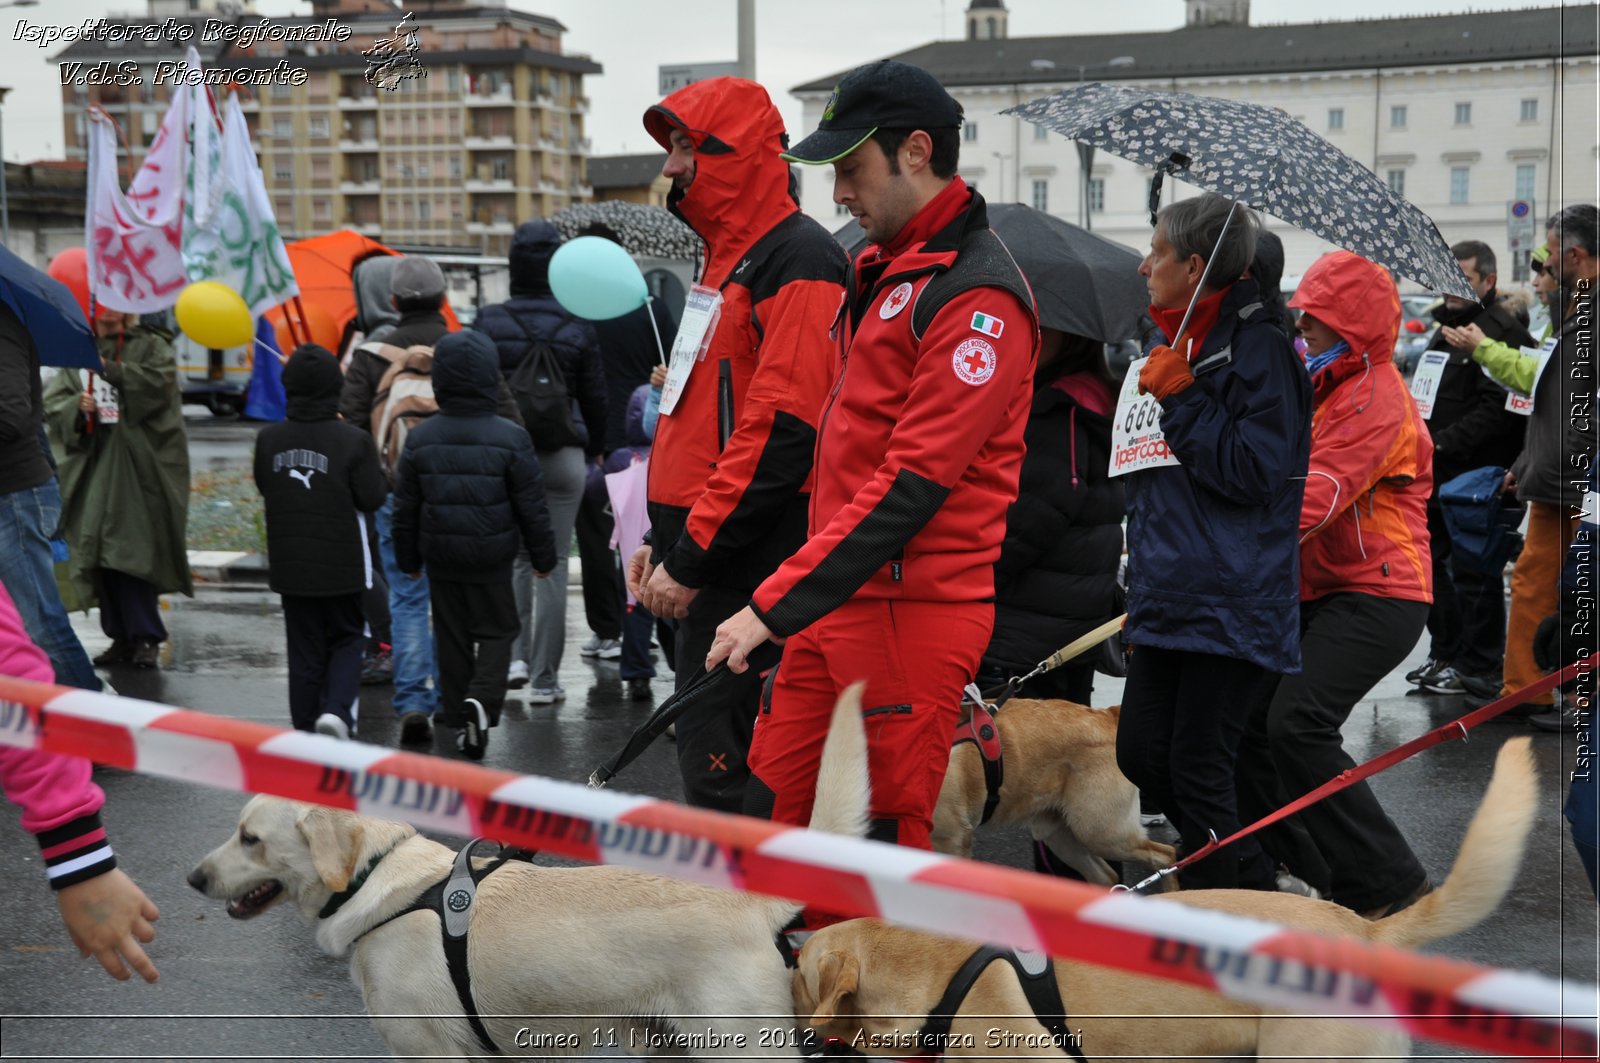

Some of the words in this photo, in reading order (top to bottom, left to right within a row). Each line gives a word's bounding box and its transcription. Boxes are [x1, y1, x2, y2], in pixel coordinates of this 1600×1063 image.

[971, 340, 988, 350] ROSSA
[1510, 392, 1533, 409] ipe
[1148, 431, 1161, 441] 2012
